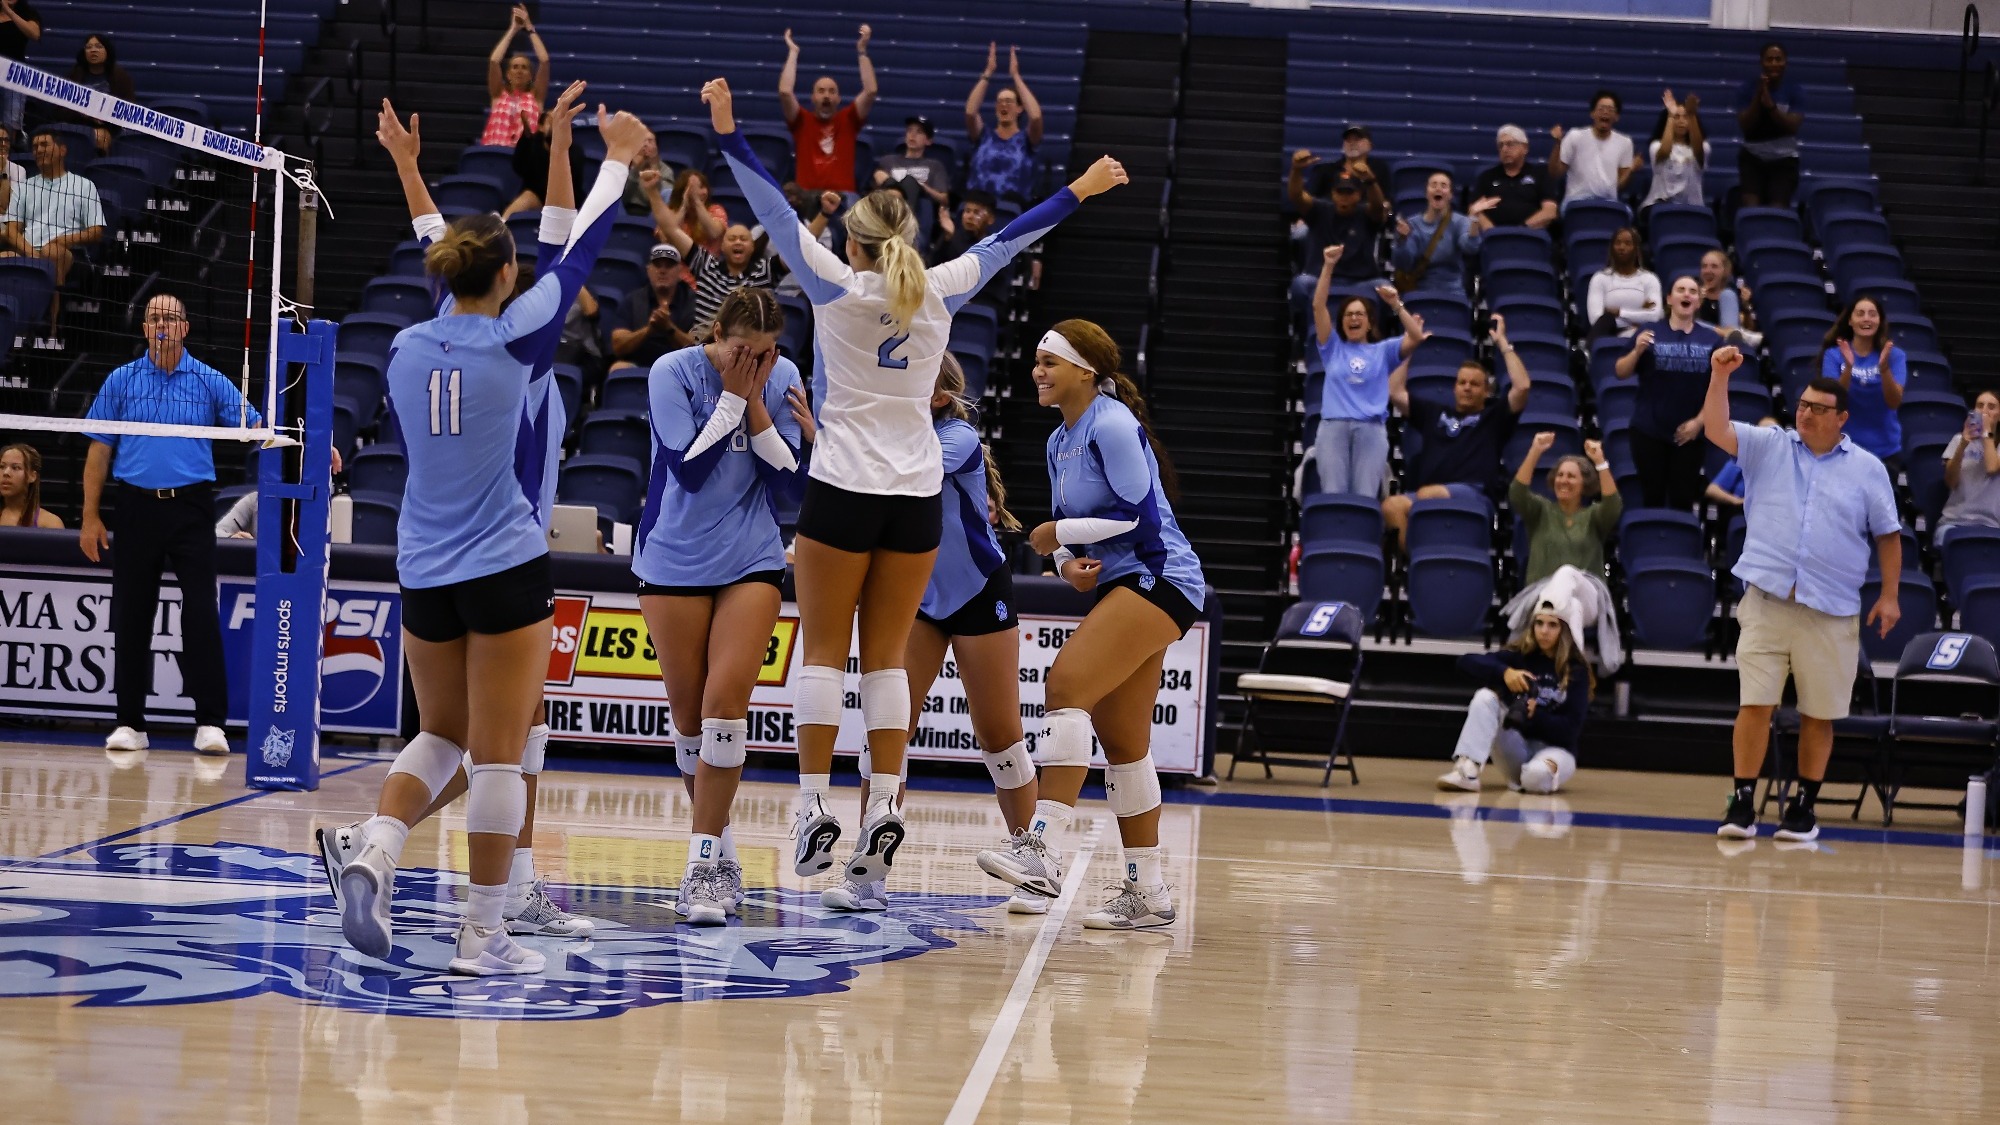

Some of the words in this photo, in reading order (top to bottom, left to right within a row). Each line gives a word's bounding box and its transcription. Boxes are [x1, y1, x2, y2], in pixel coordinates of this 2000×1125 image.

[6, 62, 44, 93] SONOMA
[44, 76, 91, 108] SEAWOLVES
[111, 100, 144, 126] SONOMA
[144, 110, 185, 139] SEAWOLVES
[203, 129, 230, 152] SONOMA
[427, 368, 462, 436] 11
[276, 599, 292, 650] sports
[584, 626, 638, 660] LES
[273, 651, 289, 713] imports
[589, 702, 671, 737] VALUE
